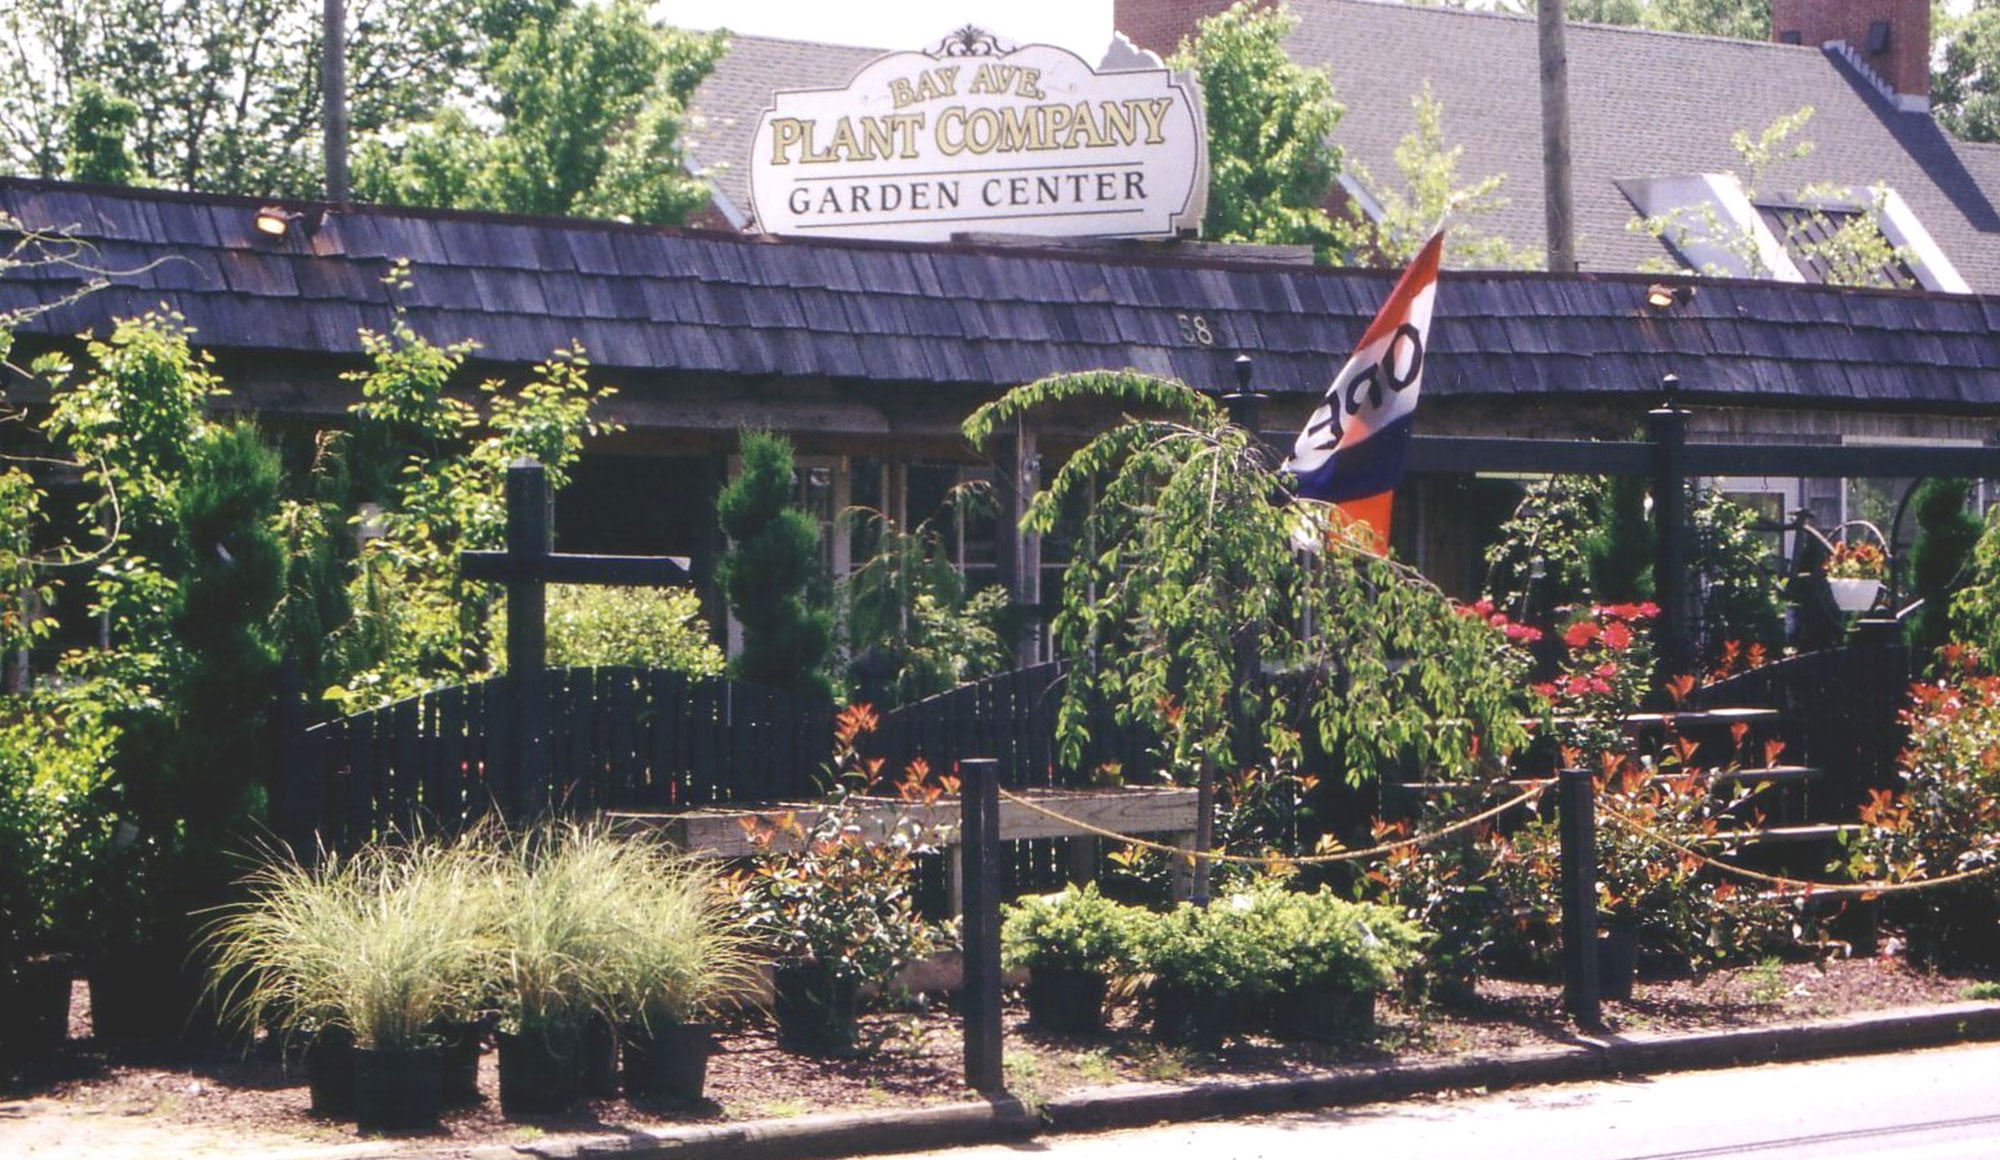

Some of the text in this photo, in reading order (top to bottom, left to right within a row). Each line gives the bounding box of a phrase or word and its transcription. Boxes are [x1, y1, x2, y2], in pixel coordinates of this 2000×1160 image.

[888, 63, 1046, 109] BAY AVE.
[769, 96, 1174, 166] PLANT COMPANY
[789, 171, 1148, 215] GARDEN CENTER
[1176, 313, 1214, 346] 58
